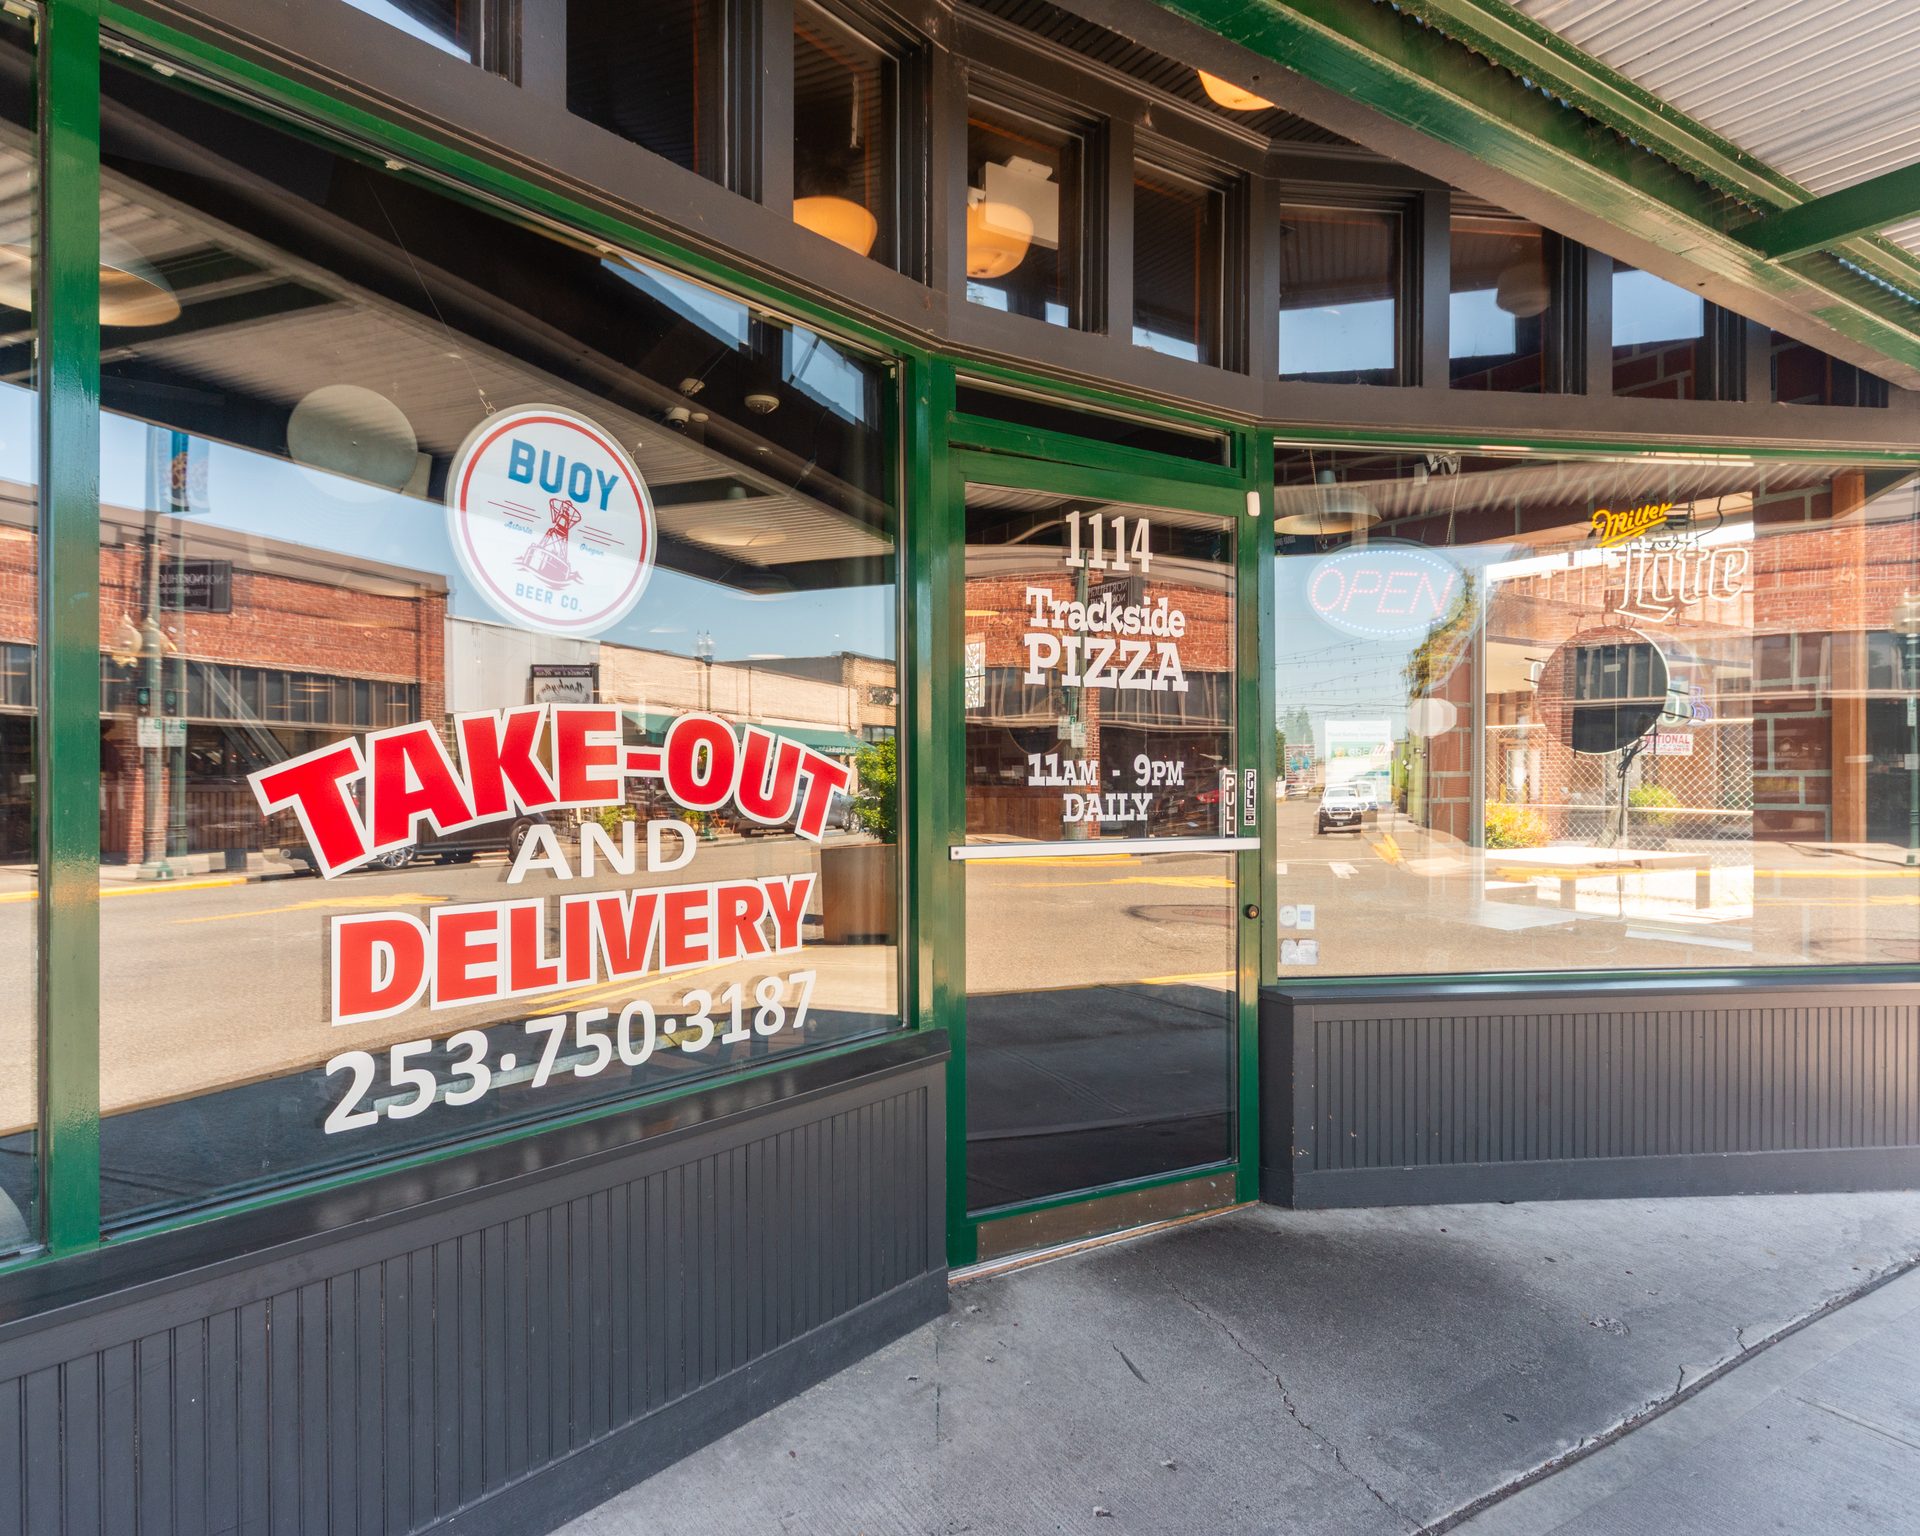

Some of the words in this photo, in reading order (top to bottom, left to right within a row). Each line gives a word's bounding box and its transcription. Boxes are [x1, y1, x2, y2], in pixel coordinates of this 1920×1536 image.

[508, 439, 619, 511] BUOY
[1065, 511, 1153, 573] 1114
[1591, 503, 1672, 541] Miller
[515, 582, 553, 604] BEER
[561, 594, 583, 612] CO.
[1311, 567, 1455, 616] OPEN
[1614, 536, 1749, 623] Lite
[1026, 586, 1186, 637] Trackside
[1024, 633, 1188, 692] PIZZA
[247, 702, 854, 880] TAKE-OUT
[1027, 753, 1098, 786] 11AM
[1133, 754, 1185, 786] 9PM
[1063, 793, 1153, 822] DAILY
[1226, 777, 1235, 834] PULL
[506, 819, 697, 884] AND
[331, 873, 817, 1027] DELIVERY
